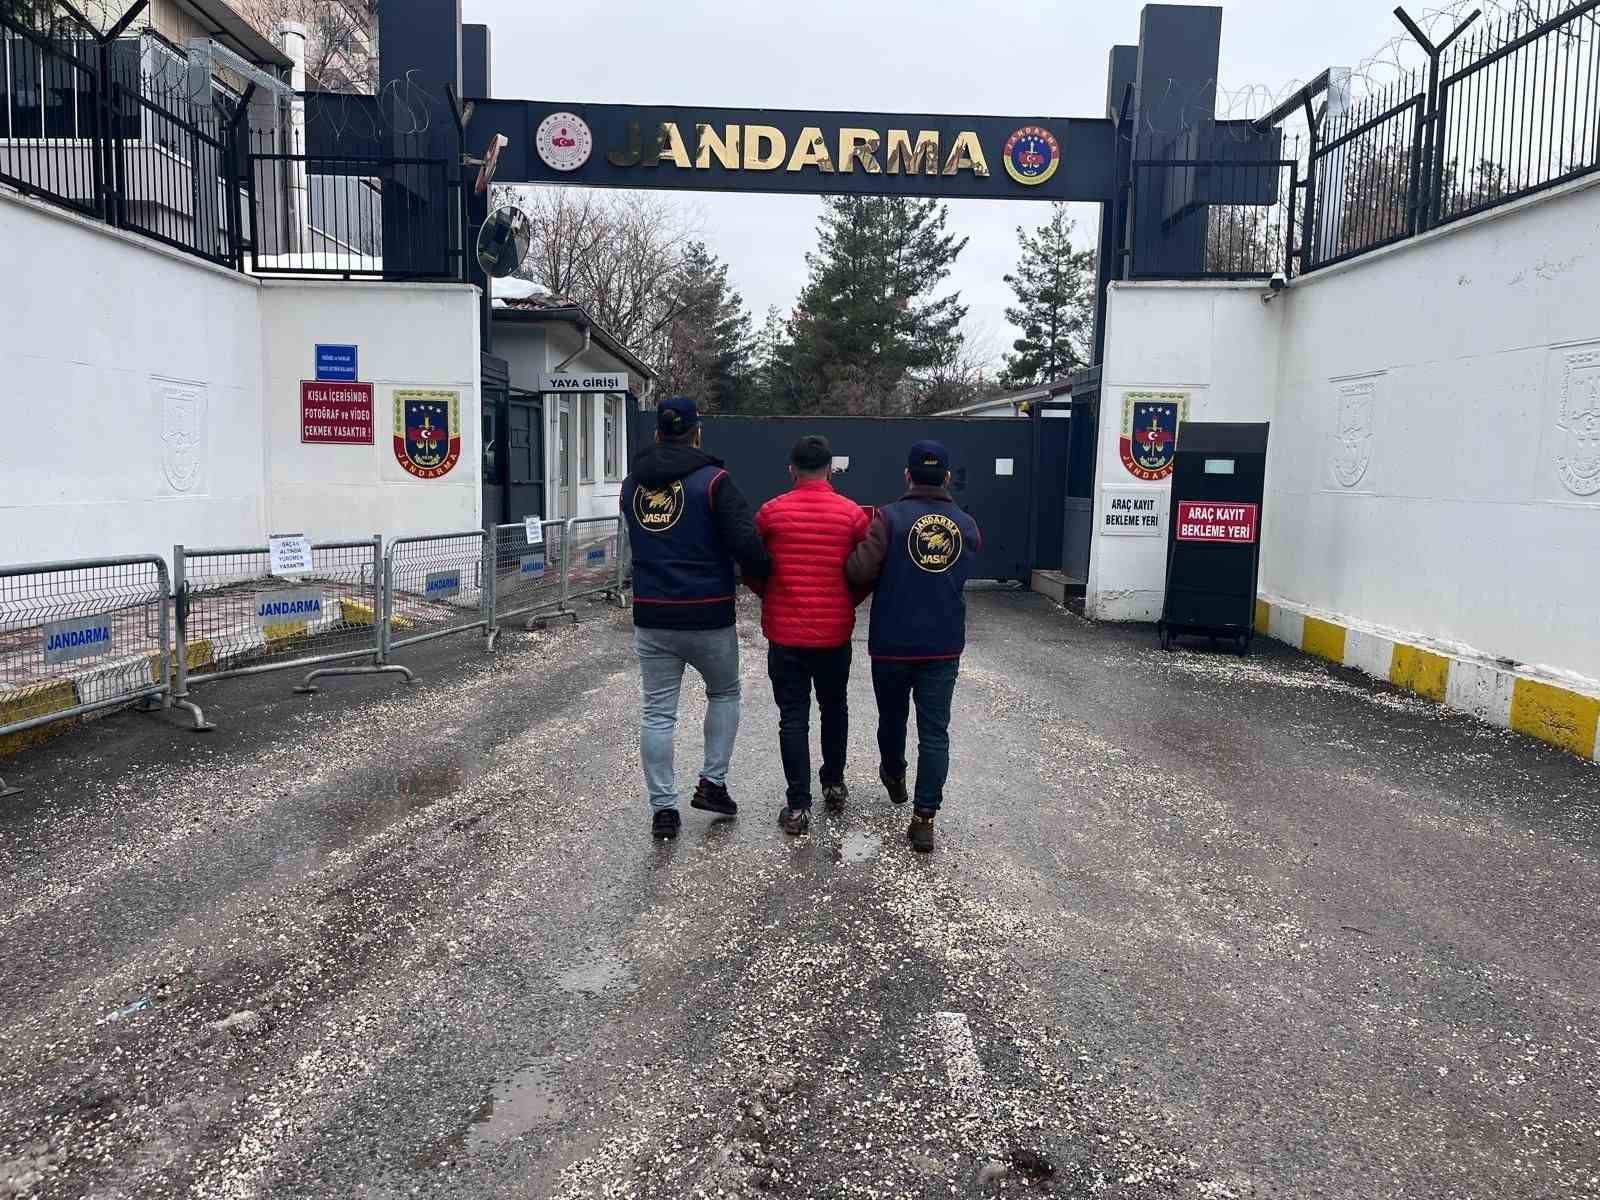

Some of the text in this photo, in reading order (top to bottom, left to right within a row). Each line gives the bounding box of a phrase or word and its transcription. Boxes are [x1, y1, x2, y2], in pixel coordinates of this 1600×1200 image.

[607, 120, 991, 177] JANDARMA
[550, 376, 619, 389] YAYA GİRİŞİ
[307, 389, 328, 402] KIŞLA
[304, 406, 370, 421] FOTOĞRAF ve VİDEO
[304, 424, 332, 439] ÇEKMEK
[1111, 499, 1154, 512] ARAÇ KAYIT
[642, 513, 672, 523] JASAT
[1106, 514, 1159, 527] BEKLEME YERİ
[1187, 508, 1245, 522] ARAÇ KAYIT
[914, 515, 960, 536] JANDARMA
[1181, 525, 1250, 539] BEKLEME YERİ
[920, 554, 948, 564] JASAT
[258, 599, 320, 617] JANDARMA
[47, 625, 110, 651] JANDARMA
